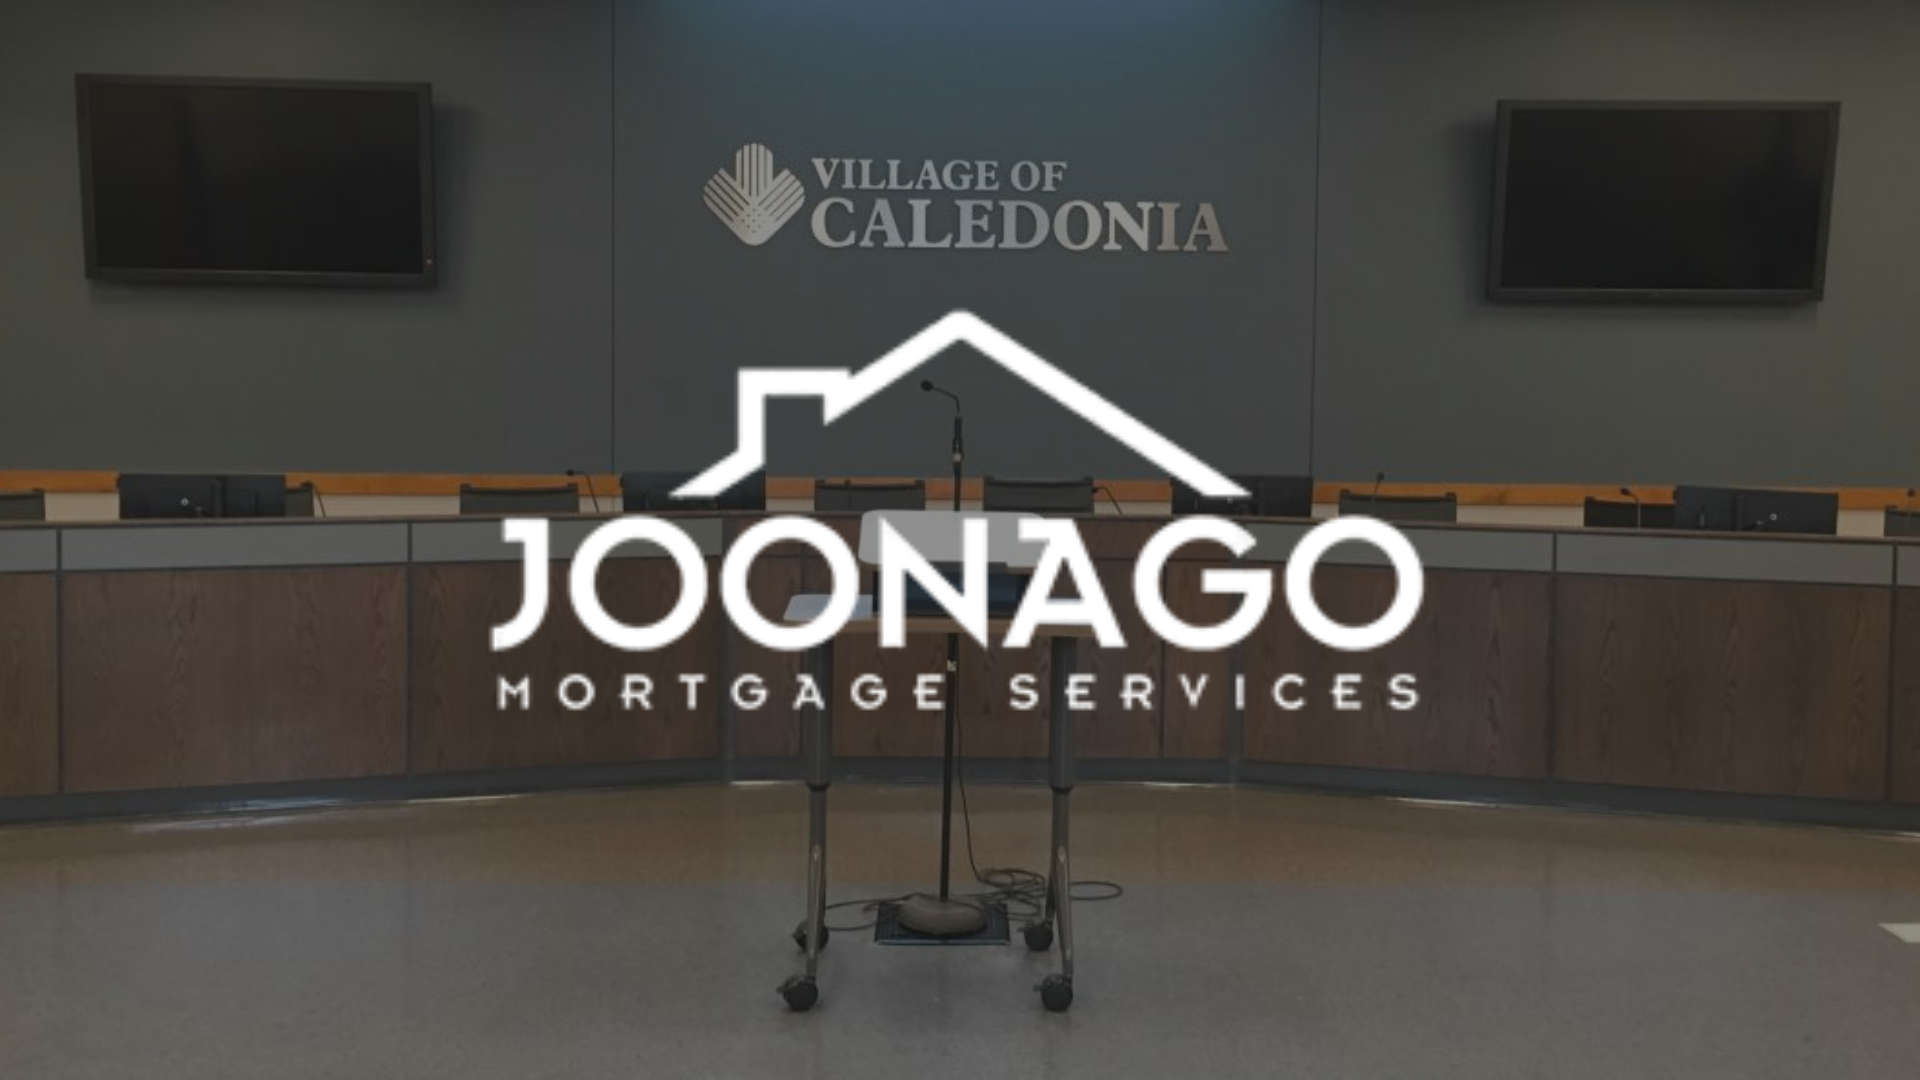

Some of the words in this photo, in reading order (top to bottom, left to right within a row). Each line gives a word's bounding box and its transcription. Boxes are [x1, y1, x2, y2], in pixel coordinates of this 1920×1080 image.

[811, 157, 999, 191] VILLAGE
[1010, 160, 1068, 192] OF
[811, 197, 1229, 252] CALEDONIA
